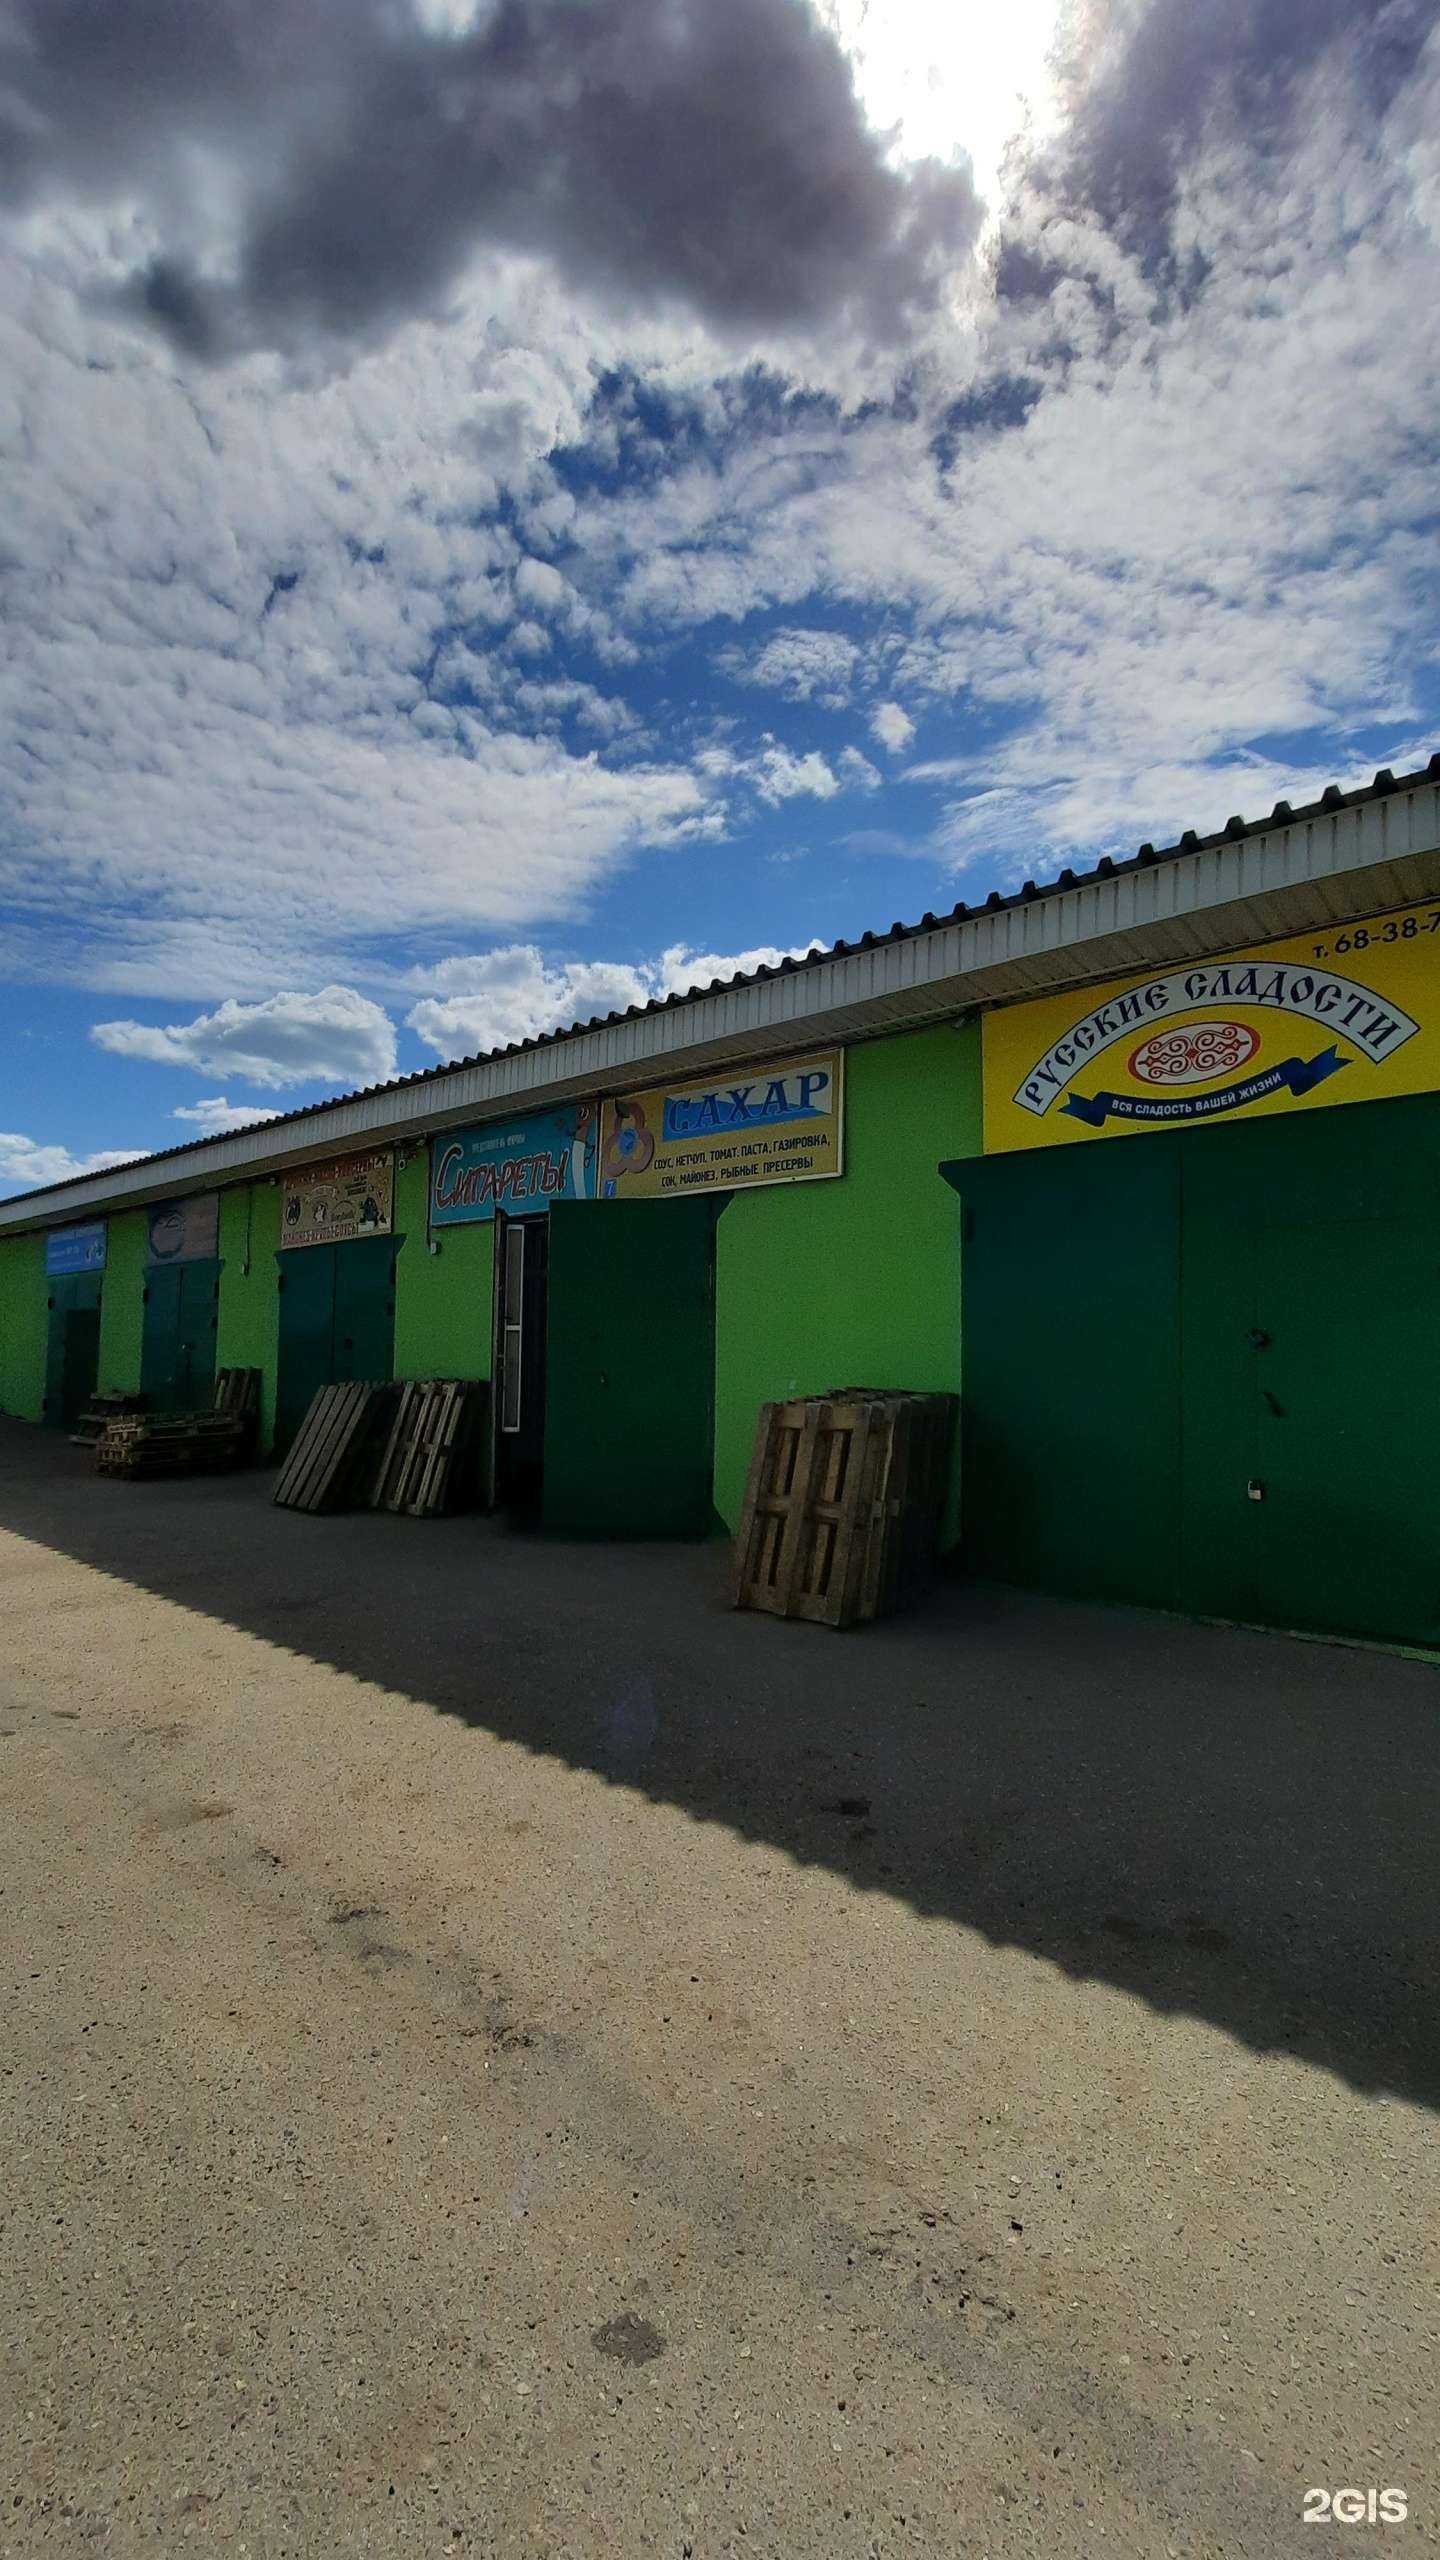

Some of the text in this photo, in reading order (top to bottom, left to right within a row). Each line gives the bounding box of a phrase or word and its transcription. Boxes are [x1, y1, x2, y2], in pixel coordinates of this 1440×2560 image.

[1025, 968, 1401, 1106] РУССКИЕ СЛАДОСТИ
[670, 1071, 829, 1131] САХАР
[1112, 1072, 1283, 1116] ВСЯ СЛАДОСТЬ ВАШЕЙ ЖИЗНИ
[720, 1164, 759, 1178] РЫБНЫЕ
[763, 1157, 813, 1175] ПРЕСЕРВЫ
